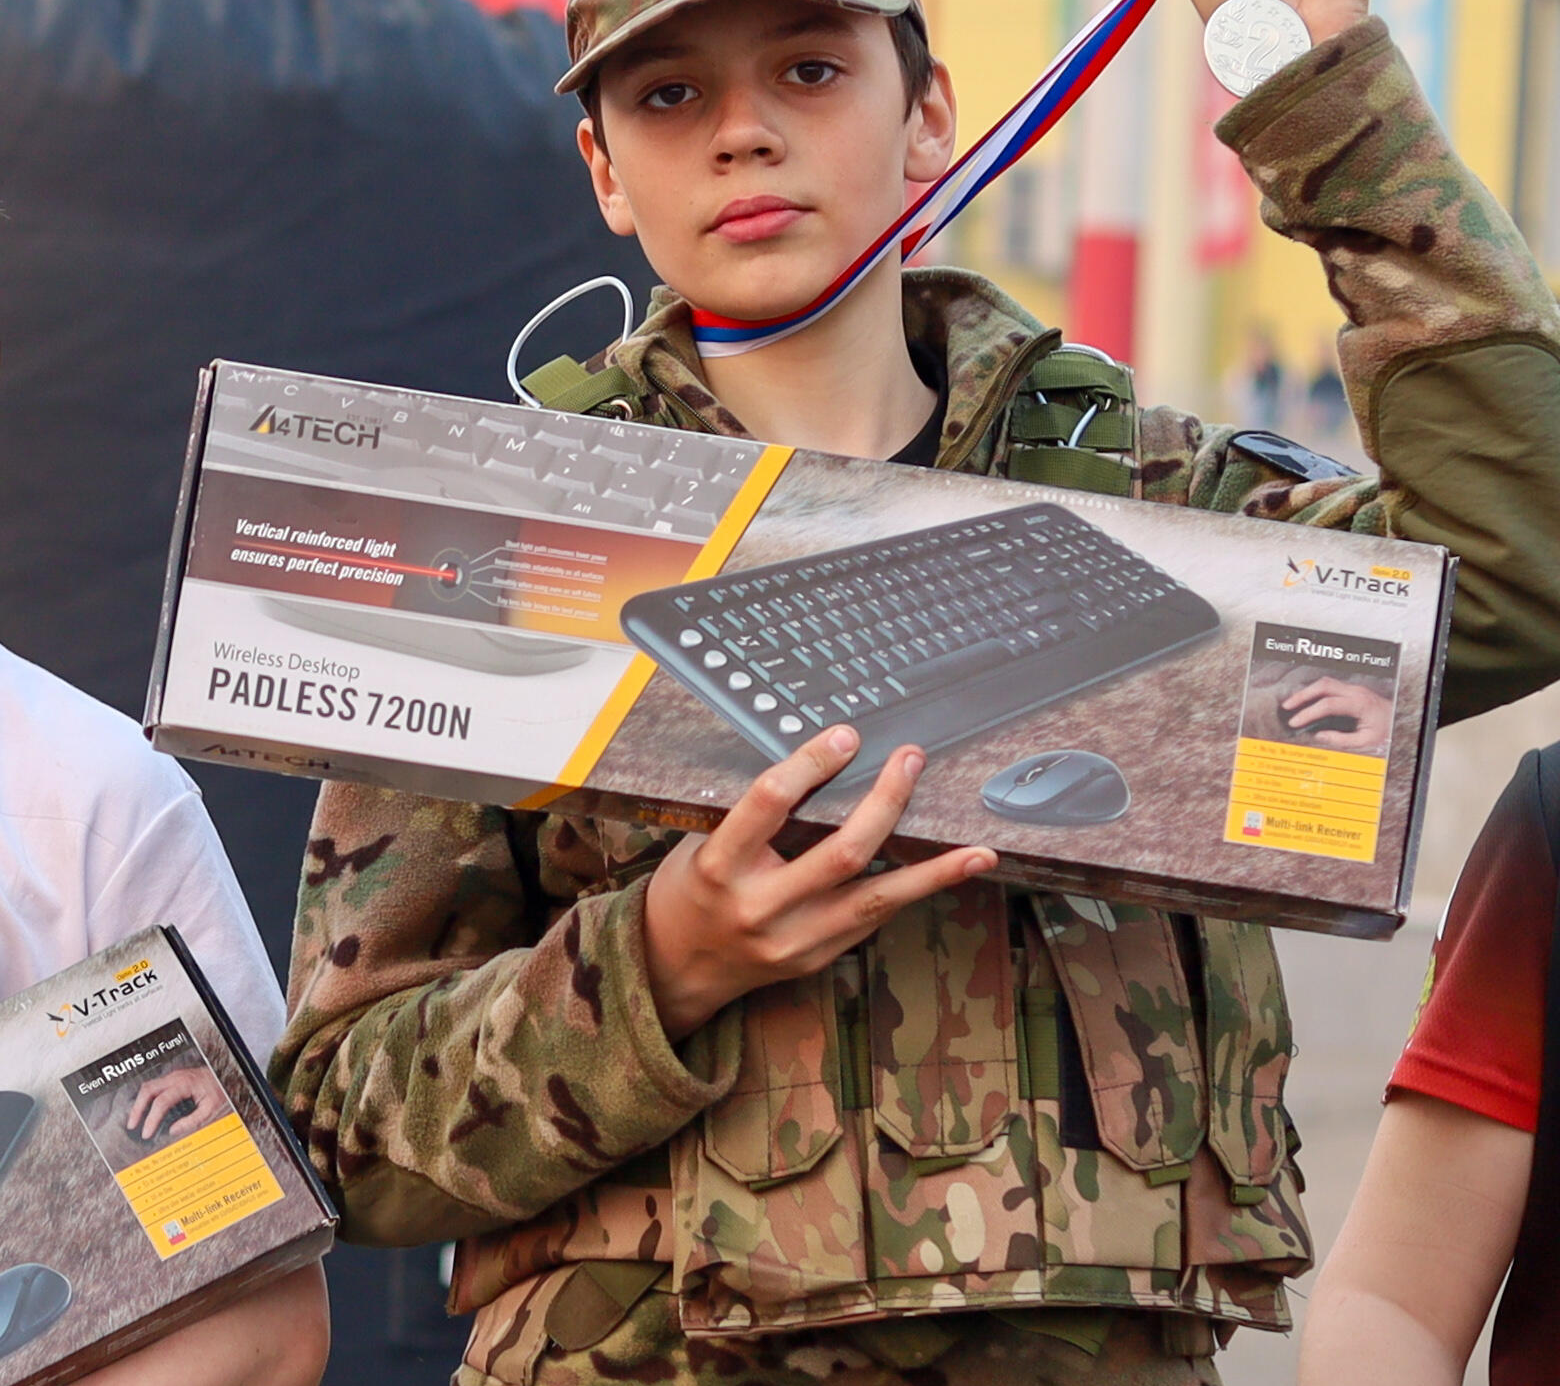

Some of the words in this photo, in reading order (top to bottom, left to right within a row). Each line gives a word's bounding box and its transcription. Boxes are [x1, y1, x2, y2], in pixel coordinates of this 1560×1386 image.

[248, 405, 381, 450] A4TECH
[235, 518, 290, 541] Vertical
[290, 530, 364, 552] reinforced
[364, 539, 397, 558] light
[231, 547, 285, 567] ensures
[285, 558, 338, 576] perfect
[338, 567, 404, 586] precision
[1315, 565, 1409, 597] V-Track
[213, 641, 283, 668] Wireless
[288, 653, 360, 682] Desktop
[1265, 638, 1294, 652] Even
[1296, 637, 1344, 660] Runs
[1346, 653, 1360, 662] on
[208, 667, 358, 721] PADLESS
[366, 693, 472, 740] 7200N
[72, 969, 158, 1017] V-Track
[78, 1076, 105, 1095] Even
[101, 1053, 145, 1082] Runs
[145, 1049, 159, 1061] on
[222, 1179, 262, 1205] Receiver
